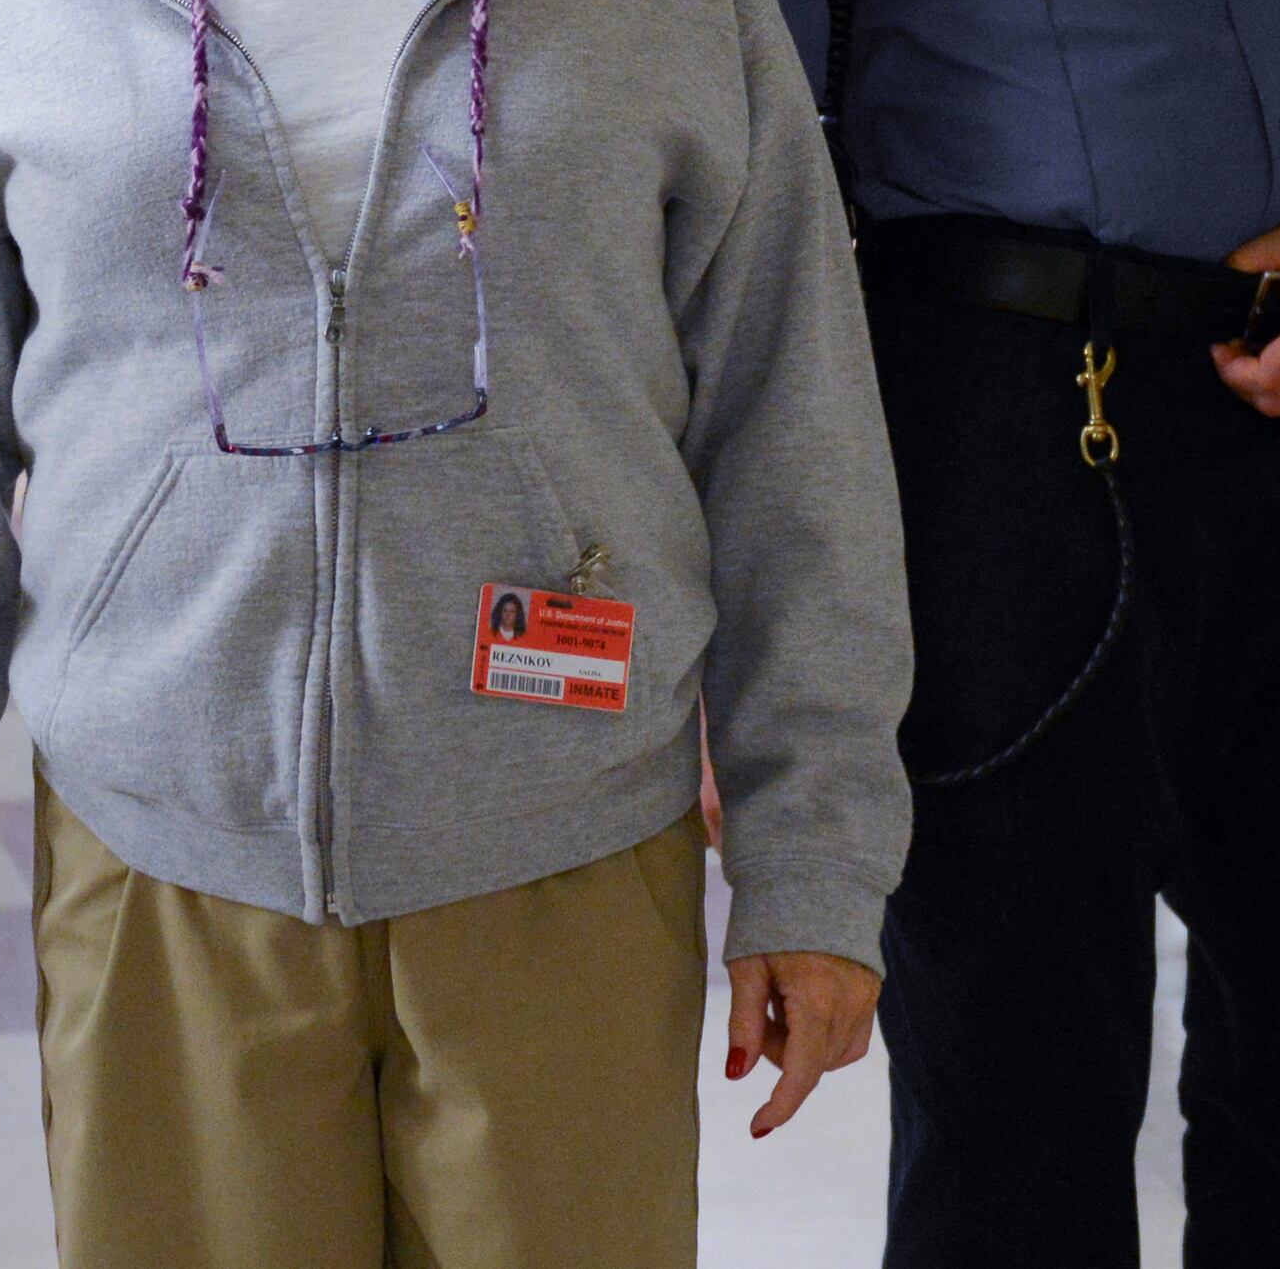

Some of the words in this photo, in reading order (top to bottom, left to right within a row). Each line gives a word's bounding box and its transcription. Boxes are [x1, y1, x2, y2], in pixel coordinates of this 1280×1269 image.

[556, 610, 595, 623] Department
[492, 651, 553, 668] REZNIKOV
[569, 682, 620, 701] INMATE
